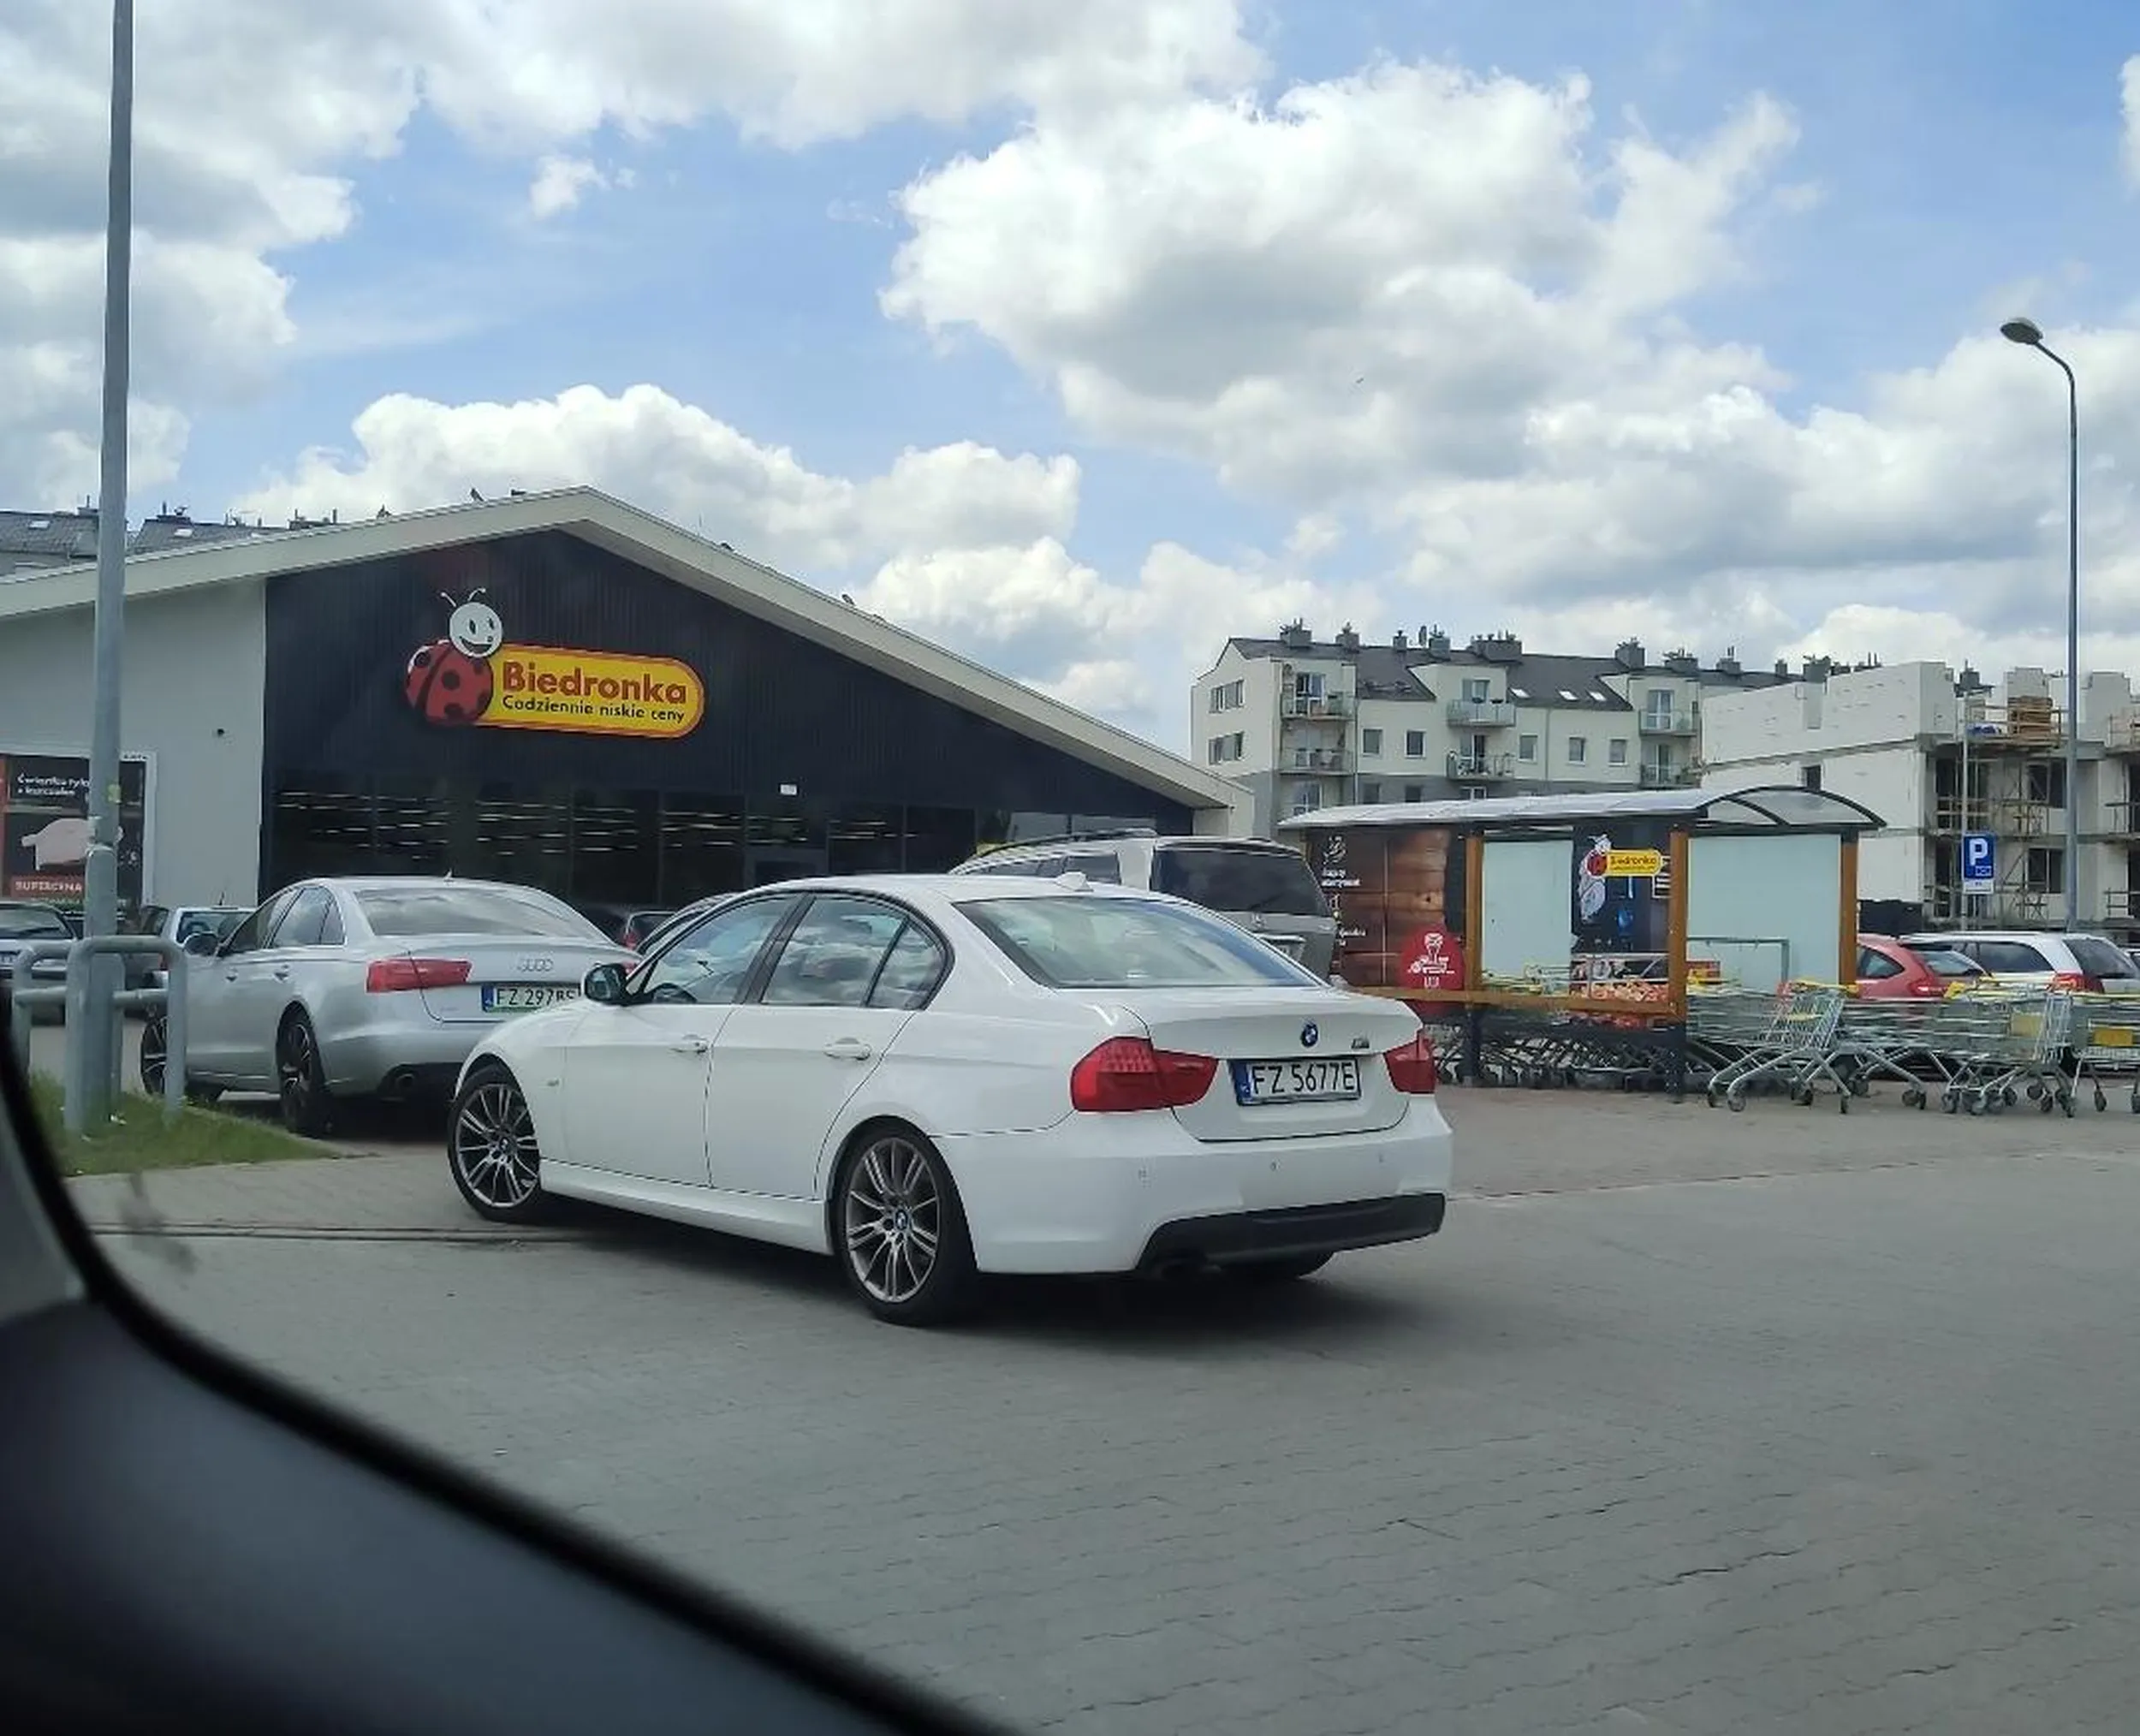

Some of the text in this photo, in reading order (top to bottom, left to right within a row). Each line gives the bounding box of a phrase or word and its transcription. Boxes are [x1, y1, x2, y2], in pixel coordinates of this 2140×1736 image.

[502, 661, 687, 704] Biedronka
[502, 695, 685, 723] Codziennie niskie ceny
[1969, 837, 1988, 866] P
[496, 988, 518, 1005] FZ
[1251, 1065, 1284, 1094] FZ
[1291, 1062, 1354, 1091] 5677E
